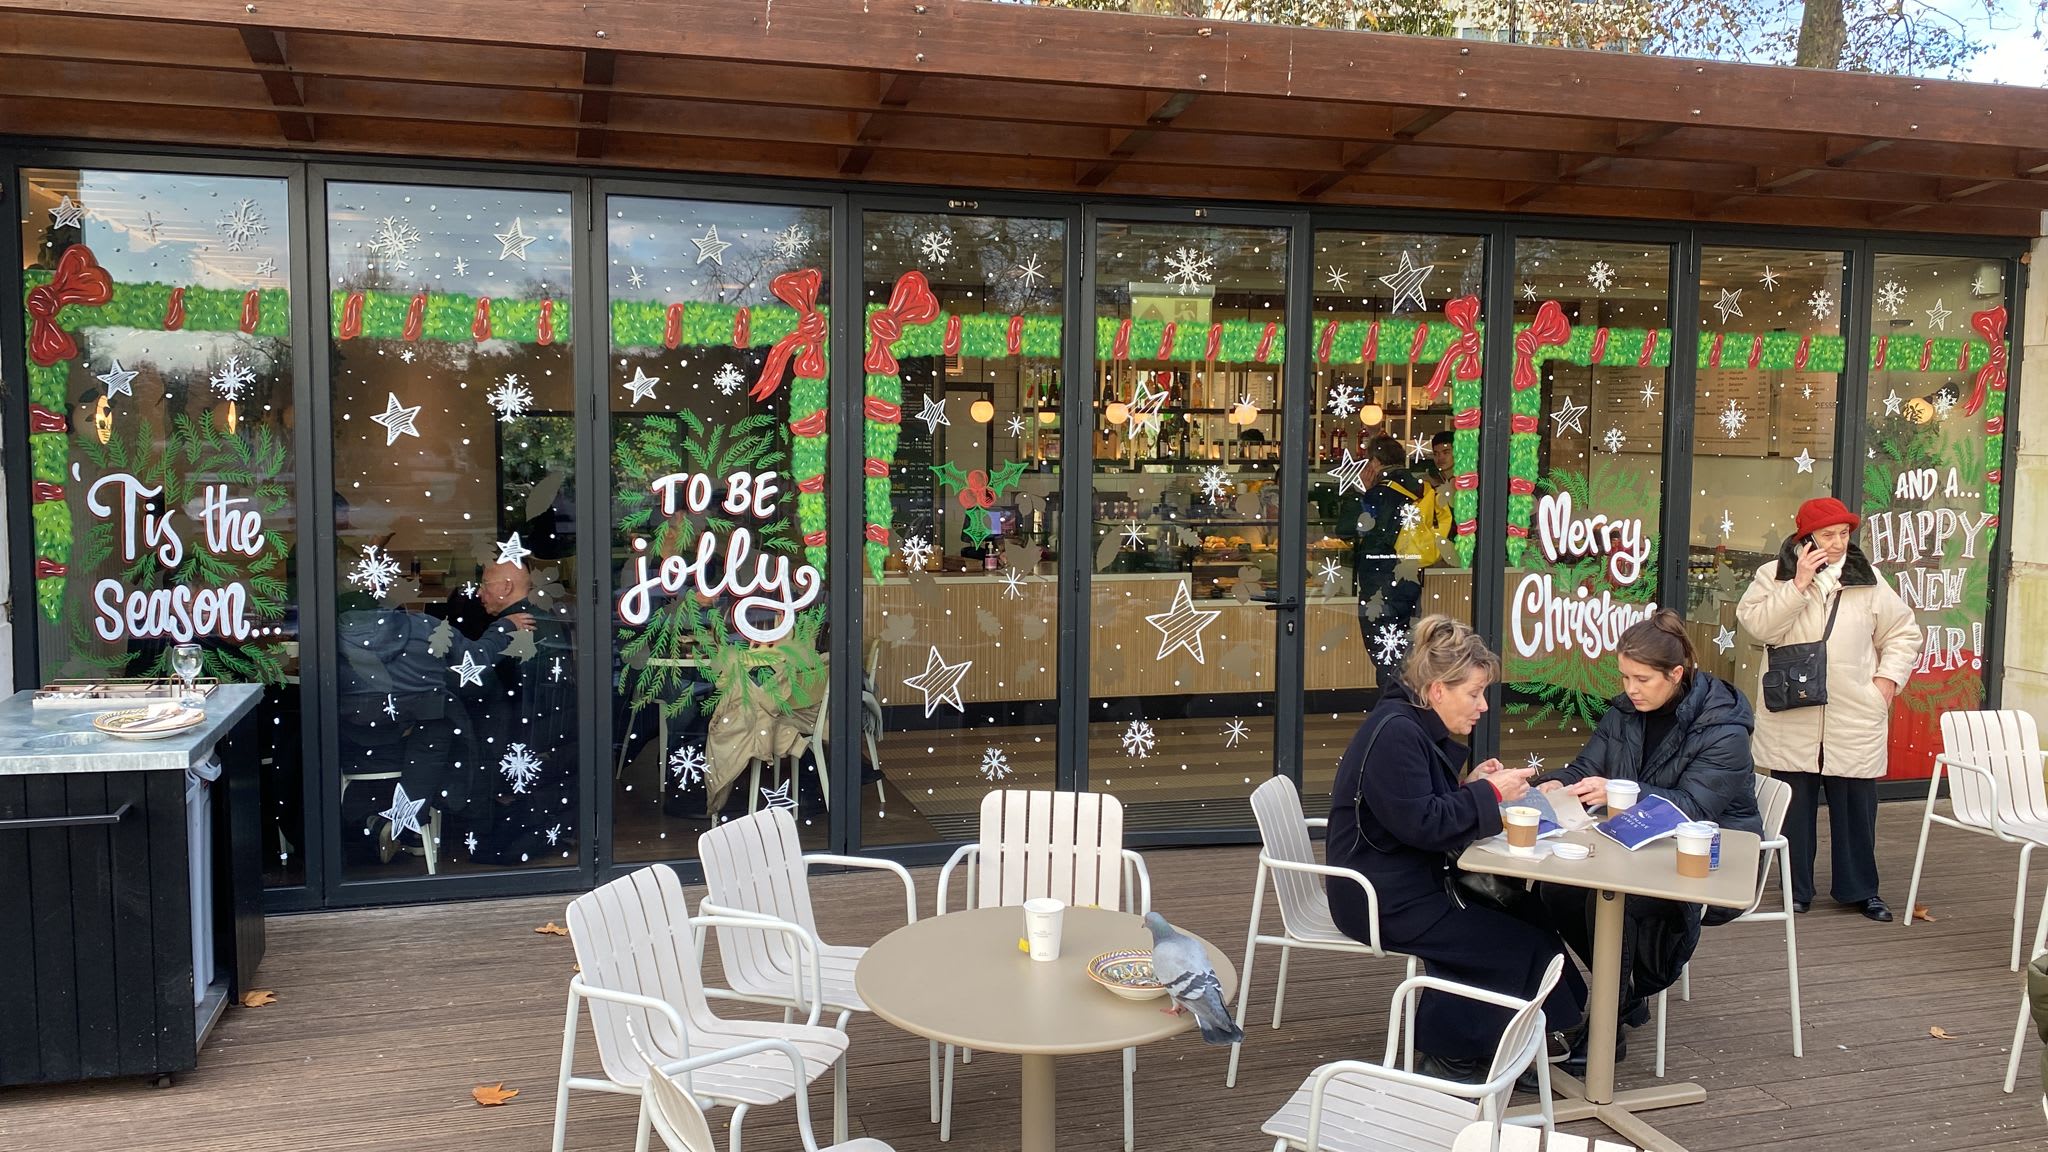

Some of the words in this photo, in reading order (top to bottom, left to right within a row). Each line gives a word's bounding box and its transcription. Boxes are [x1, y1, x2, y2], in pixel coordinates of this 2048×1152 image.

[651, 472, 712, 517] TO
[722, 471, 779, 518] BE
[1895, 468, 1938, 501] AND
[1944, 467, 1981, 499] A...
[72, 462, 183, 569] 'Tis
[199, 484, 265, 557] the
[1538, 491, 1651, 585] Merry
[1867, 508, 1994, 567] HAPPY
[94, 578, 282, 644] Season...
[618, 527, 821, 643] jolly
[1895, 568, 1968, 612] NEW
[1912, 622, 1982, 675] AR!
